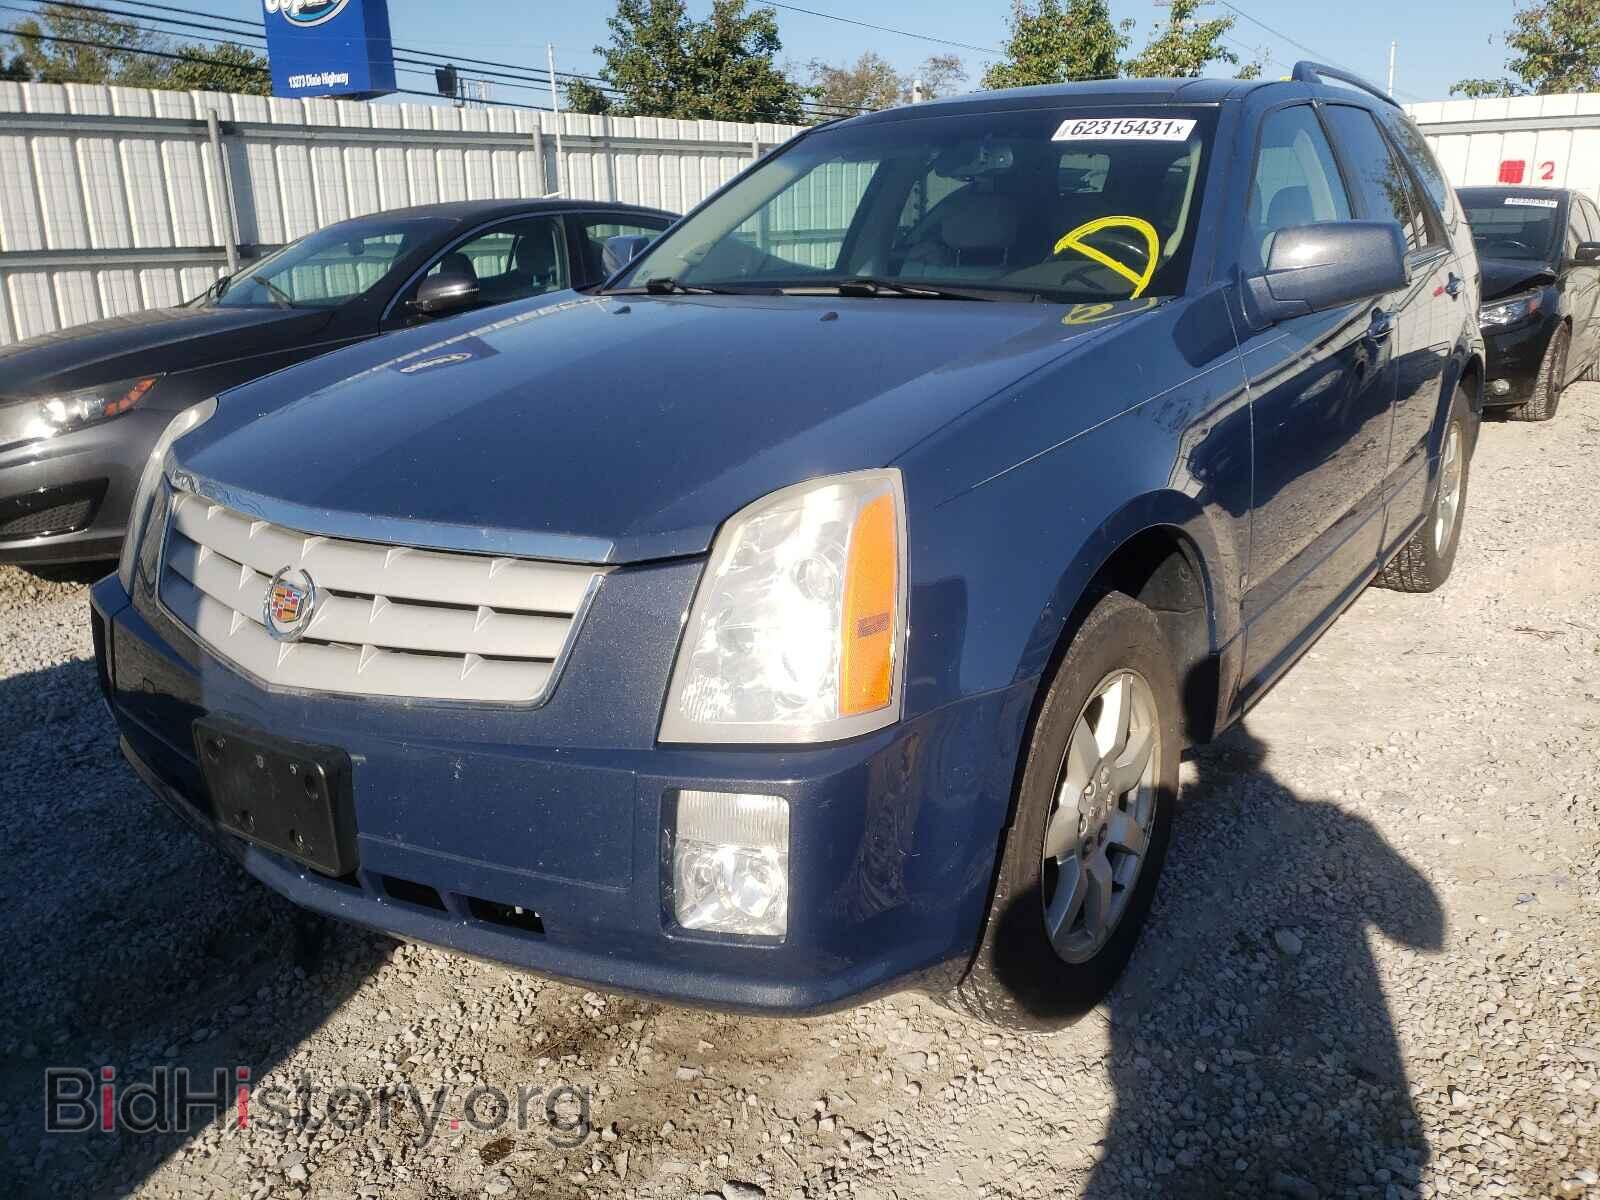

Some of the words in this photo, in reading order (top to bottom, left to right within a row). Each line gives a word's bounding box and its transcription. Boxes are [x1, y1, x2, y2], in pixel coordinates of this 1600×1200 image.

[321, 72, 349, 88] Highway
[1070, 120, 1174, 136] 62315431
[1540, 161, 1555, 180] 2
